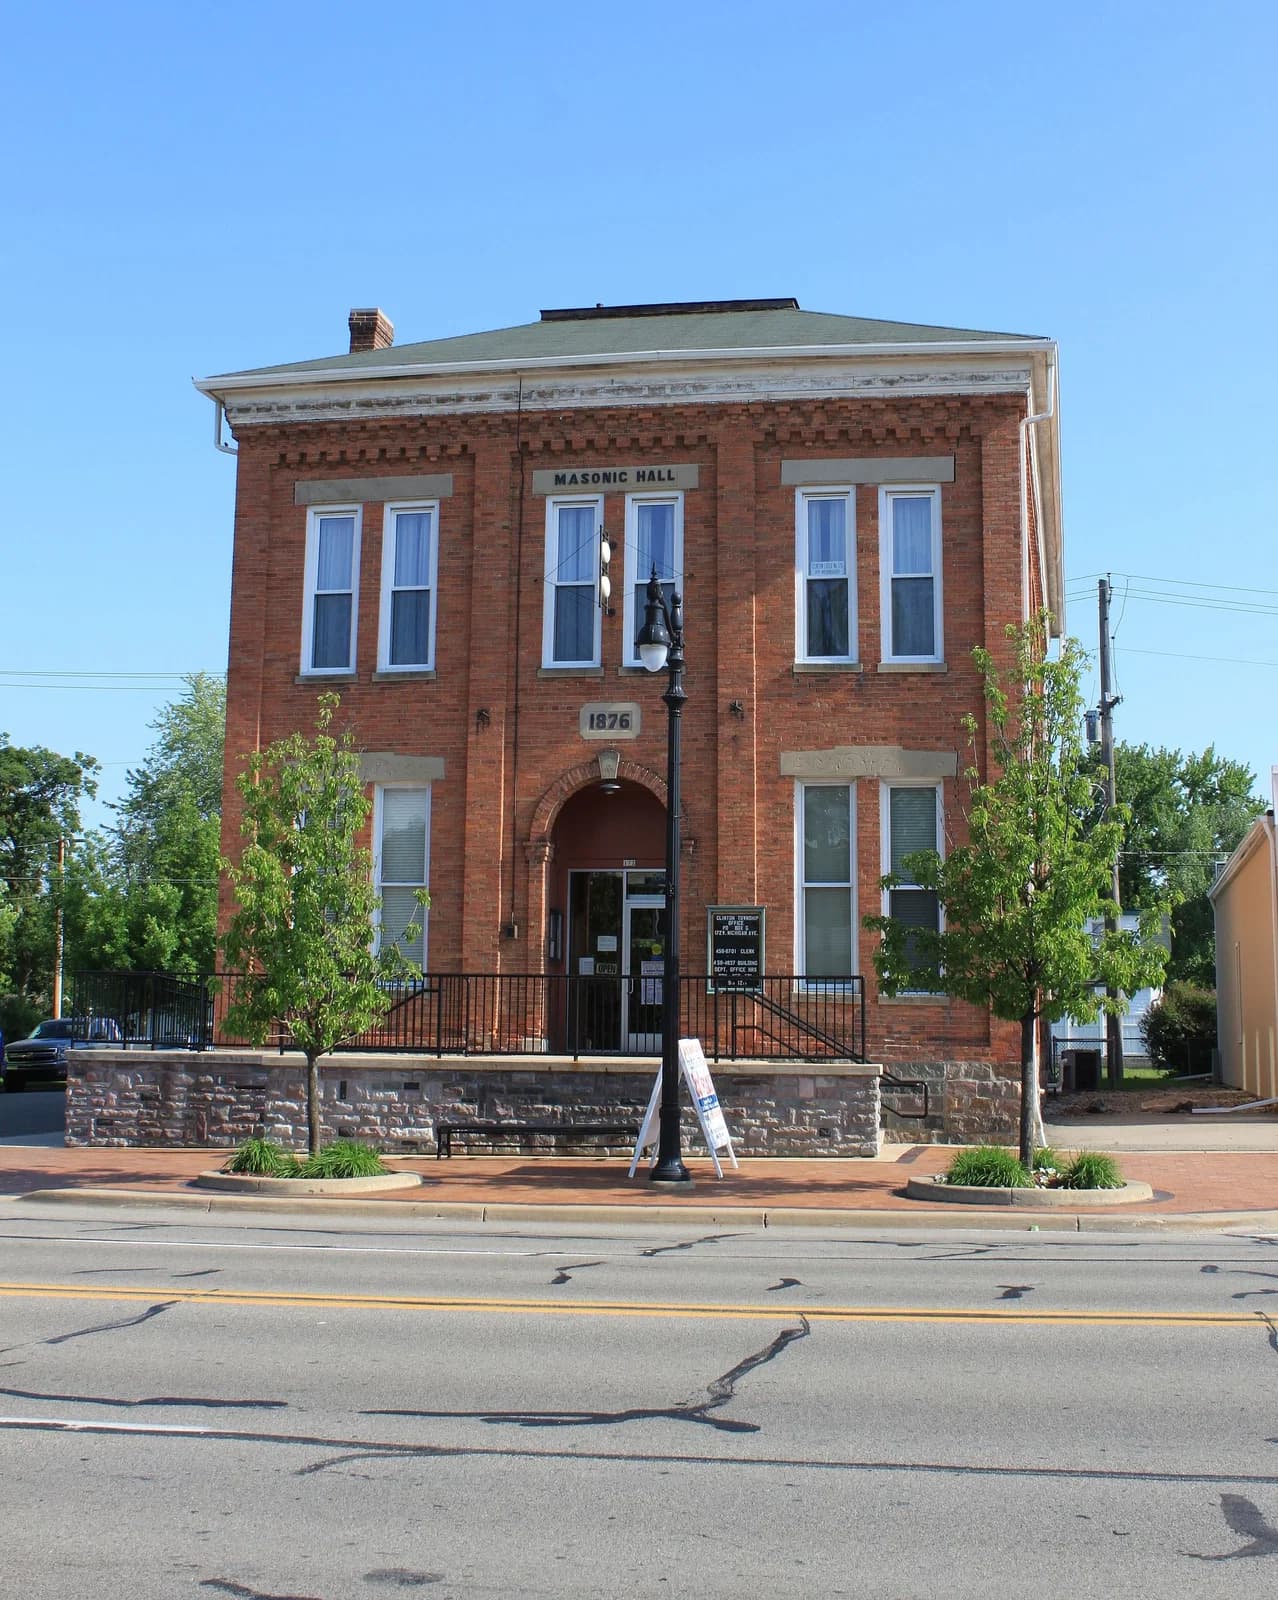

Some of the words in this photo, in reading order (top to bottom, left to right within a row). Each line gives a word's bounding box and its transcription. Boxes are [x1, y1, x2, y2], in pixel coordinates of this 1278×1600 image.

[555, 472, 628, 486] MASONIC
[636, 470, 675, 482] HALL
[590, 713, 630, 729] 1876
[598, 964, 616, 974] OPEN
